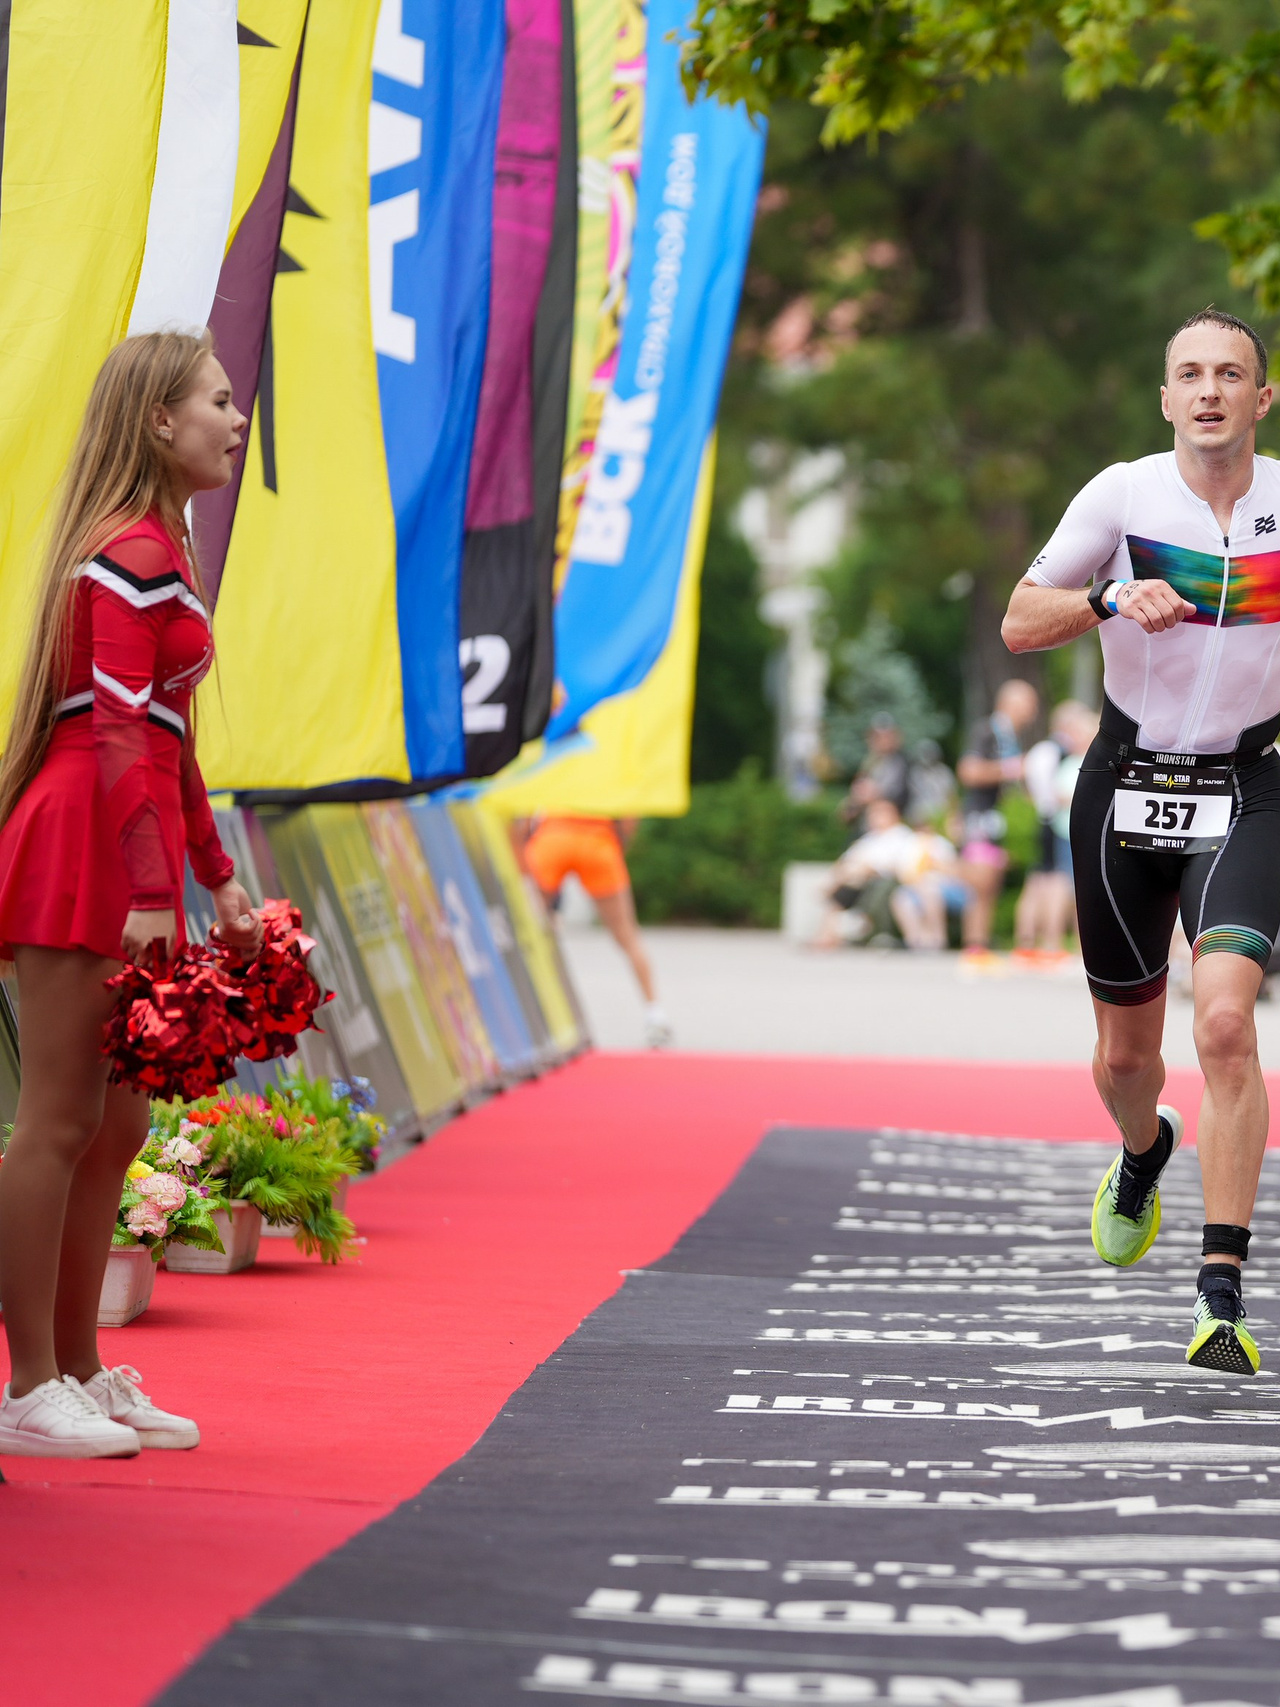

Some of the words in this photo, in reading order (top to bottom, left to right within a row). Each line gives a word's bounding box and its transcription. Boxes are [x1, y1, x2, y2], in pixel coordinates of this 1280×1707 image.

[571, 389, 658, 565] ВСК
[1123, 579, 1145, 598] 25
[1155, 753, 1197, 766] IRONSTAR
[1153, 773, 1167, 782] IRON
[1174, 775, 1190, 783] STAR
[1145, 800, 1197, 831] 257
[1152, 838, 1185, 848] DMITRIY
[761, 1328, 1040, 1342] IRON
[726, 1395, 1040, 1416] IRON
[670, 1486, 1036, 1504] IRON
[584, 1588, 1029, 1632] IRON
[535, 1655, 1022, 1705] IRON
